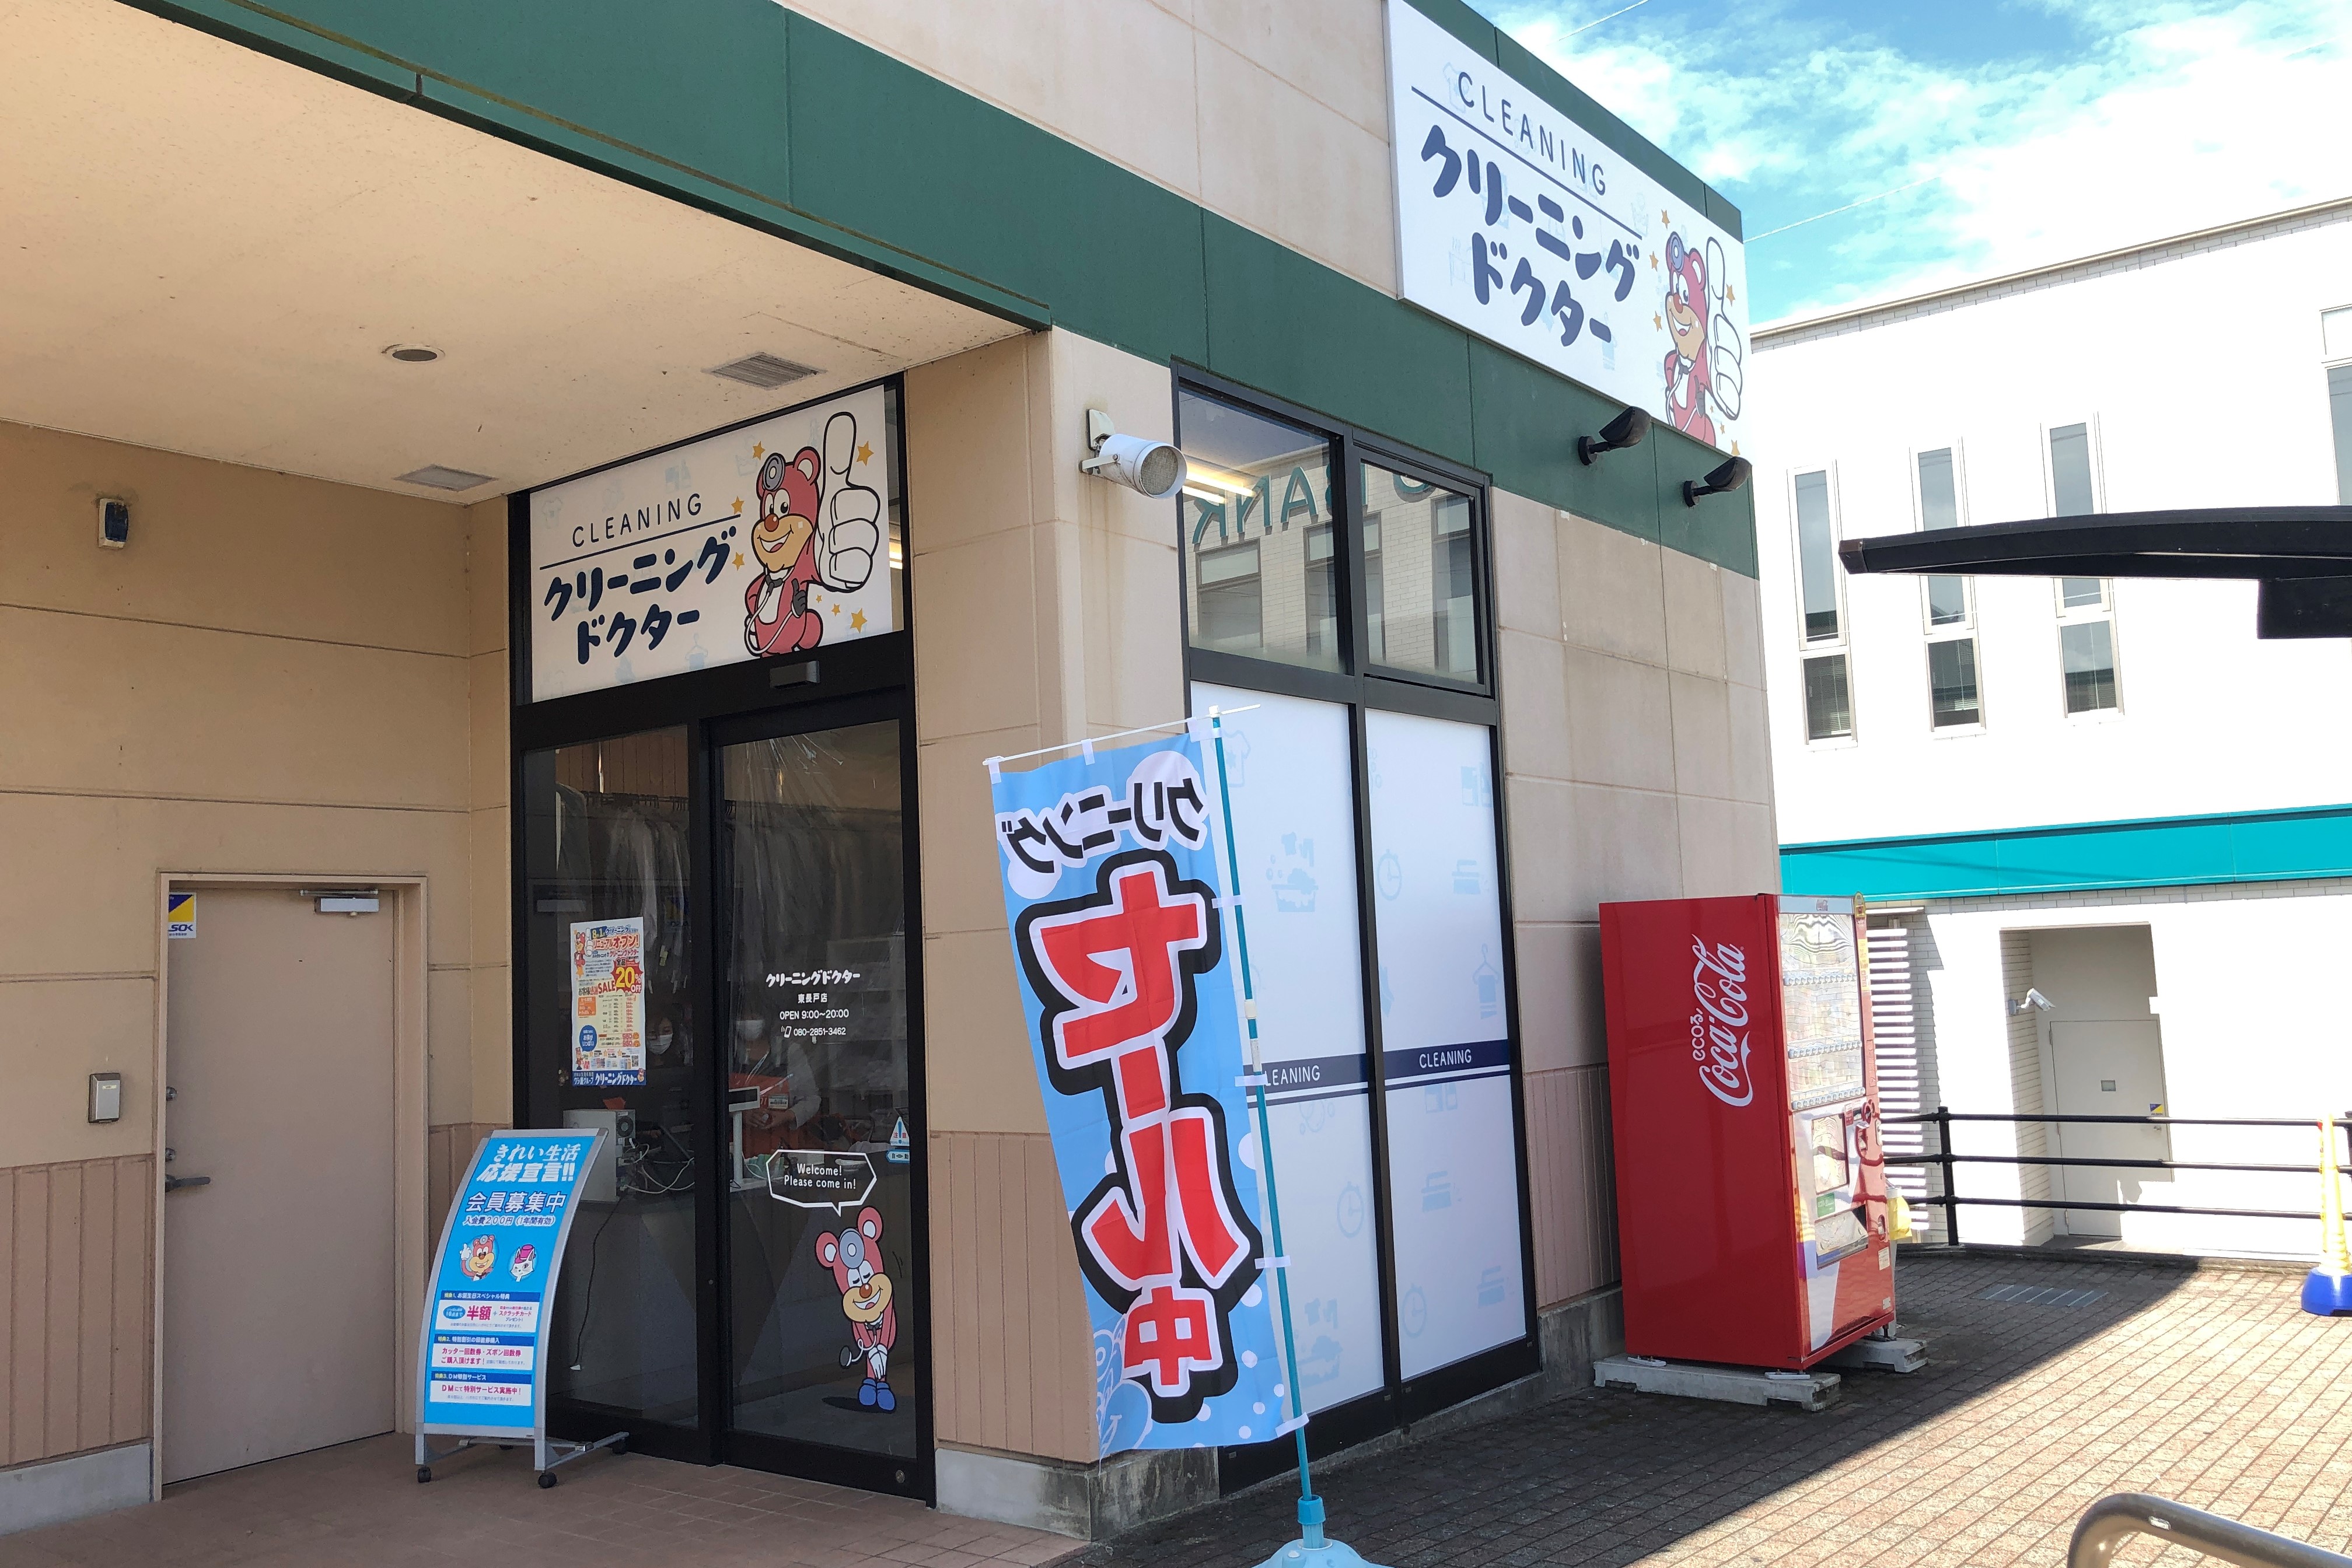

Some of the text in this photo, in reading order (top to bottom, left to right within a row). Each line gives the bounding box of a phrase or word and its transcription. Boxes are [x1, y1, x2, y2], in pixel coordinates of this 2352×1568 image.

[1459, 72, 1606, 196] CLEANING
[1421, 125, 1640, 302] クリーニング
[1472, 232, 1611, 346] ドクター
[572, 493, 702, 547] CLEANING
[544, 526, 736, 621] クリーニング
[577, 603, 700, 665] ドクター
[598, 980, 616, 994] SALE
[631, 984, 641, 992] OFF
[766, 969, 861, 988] クリーニングドクター
[798, 993, 828, 1003] 東長戸店
[780, 1011, 799, 1020] OPEN
[1691, 933, 1753, 1107] Coca-Cola
[794, 1027, 846, 1036] 080-2851-3462
[1419, 1048, 1472, 1069] CLEANING
[595, 1072, 637, 1085] クリーニングドクター
[1264, 1065, 1321, 1086] LEANING
[494, 1143, 581, 1163] きれい生活
[476, 1162, 576, 1183] 応援宣言!!
[796, 1163, 842, 1176] Welcome!
[784, 1175, 856, 1189] Please come in!
[464, 1191, 568, 1214] 会員募集中
[467, 1305, 492, 1321] 半額
